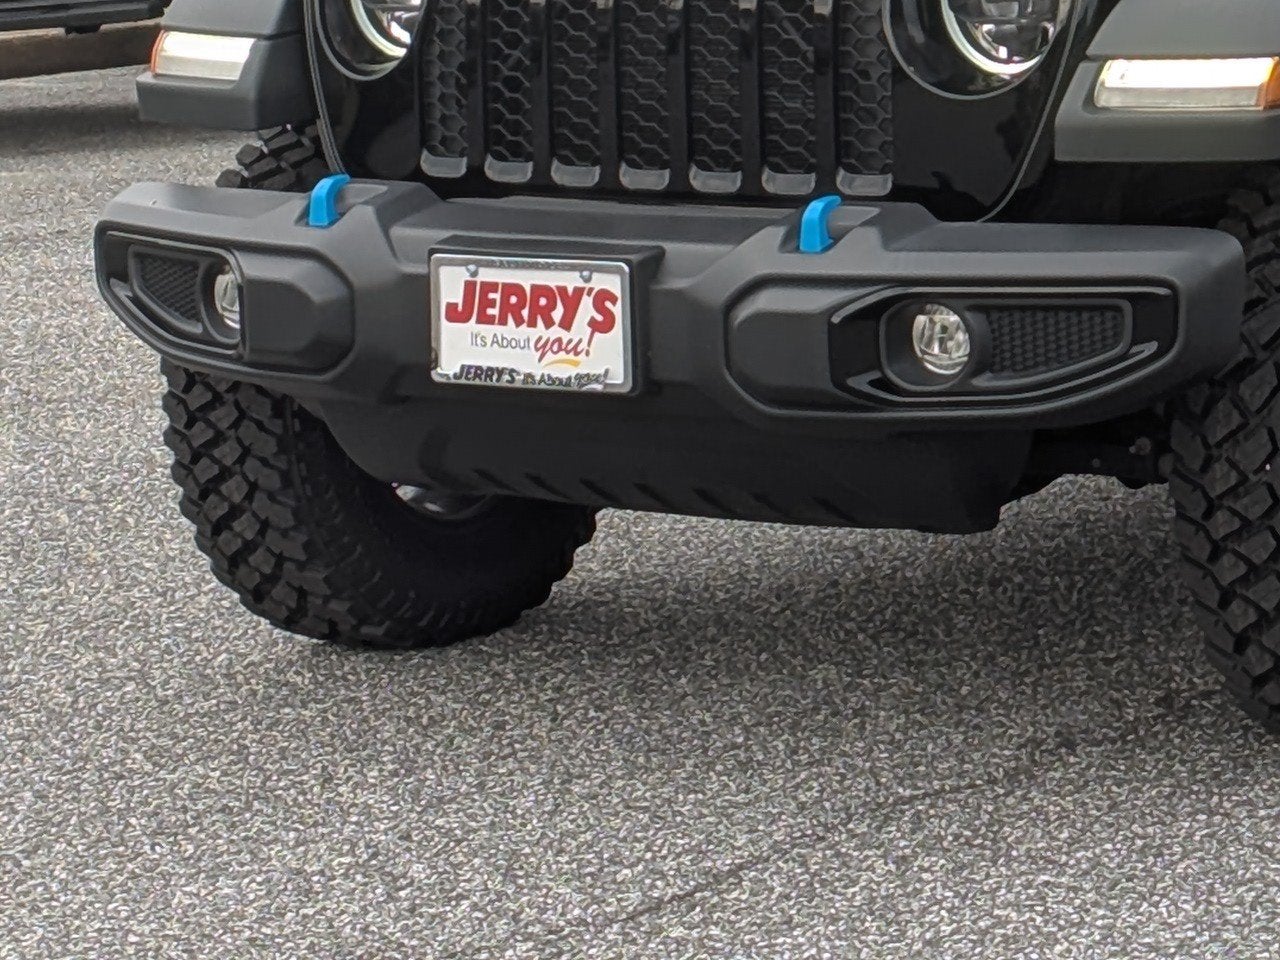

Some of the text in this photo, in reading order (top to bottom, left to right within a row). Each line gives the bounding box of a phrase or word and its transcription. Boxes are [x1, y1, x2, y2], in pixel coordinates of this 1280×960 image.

[444, 279, 619, 334] JERRY'S
[470, 328, 596, 364] It's About you!
